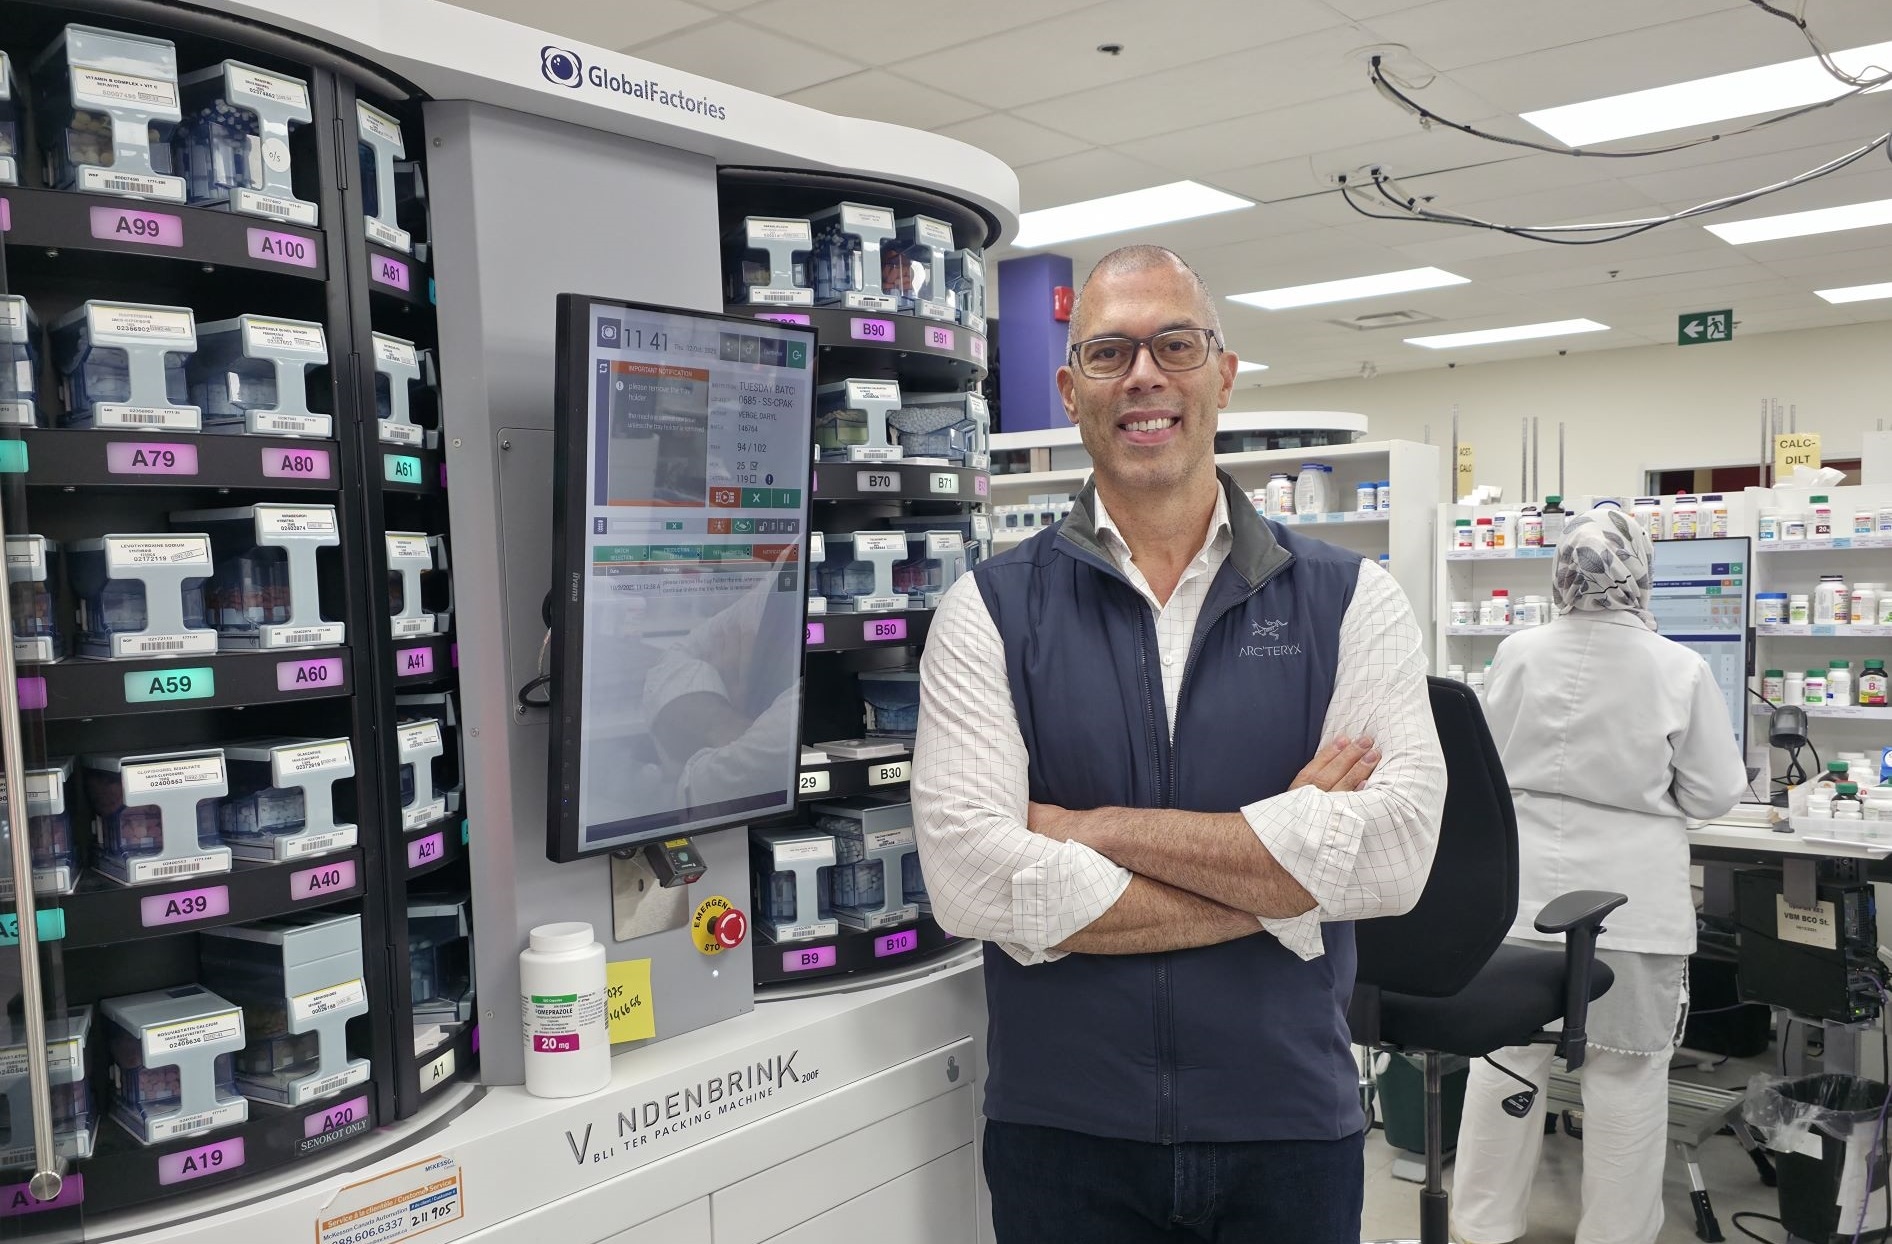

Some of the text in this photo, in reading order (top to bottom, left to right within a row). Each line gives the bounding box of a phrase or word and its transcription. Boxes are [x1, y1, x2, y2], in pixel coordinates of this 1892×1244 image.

[114, 79, 138, 87] COMPLEX
[589, 65, 726, 120] GlobalFactories
[116, 216, 160, 238] A99
[262, 237, 304, 259] A100
[383, 263, 400, 282] A81
[864, 324, 885, 337] B90
[934, 331, 947, 344] B91
[659, 368, 693, 377] NOTIFICATION
[740, 382, 796, 396] TUESDAY BATC
[737, 443, 746, 452] 94
[754, 443, 767, 453] 102
[1779, 439, 1816, 449] CALC-
[132, 450, 175, 468] A79
[281, 455, 313, 473] A80
[737, 462, 745, 470] 25
[1786, 455, 1811, 464] DILT
[396, 461, 413, 477] A61
[870, 475, 890, 488] B70
[938, 477, 952, 489] B71
[876, 624, 897, 636] B50
[1239, 643, 1302, 657] ARC'TERYX
[408, 654, 424, 670] A41
[296, 666, 327, 683] A60
[149, 676, 192, 694] A59
[881, 767, 901, 780] B30
[419, 841, 435, 859] A21
[309, 870, 340, 891] A40
[165, 896, 207, 917] A39
[1784, 912, 1829, 926] VBM BCO St.
[887, 936, 907, 950] B10
[802, 953, 819, 966] B9
[542, 1038, 556, 1049] 20
[432, 1063, 444, 1080] A1
[801, 1069, 819, 1083] 200F
[322, 1107, 354, 1131] A20
[655, 1110, 712, 1139] PACKING
[718, 1087, 773, 1115] MACHINE
[301, 1120, 367, 1151] SENOKOT ONLY
[182, 1150, 223, 1174] A19
[328, 1218, 353, 1229] Service
[398, 1188, 428, 1203] Customer
[429, 1179, 452, 1192] Service
[412, 1201, 456, 1226] 211 905
[323, 1207, 408, 1240] McKesson Canada Automation
